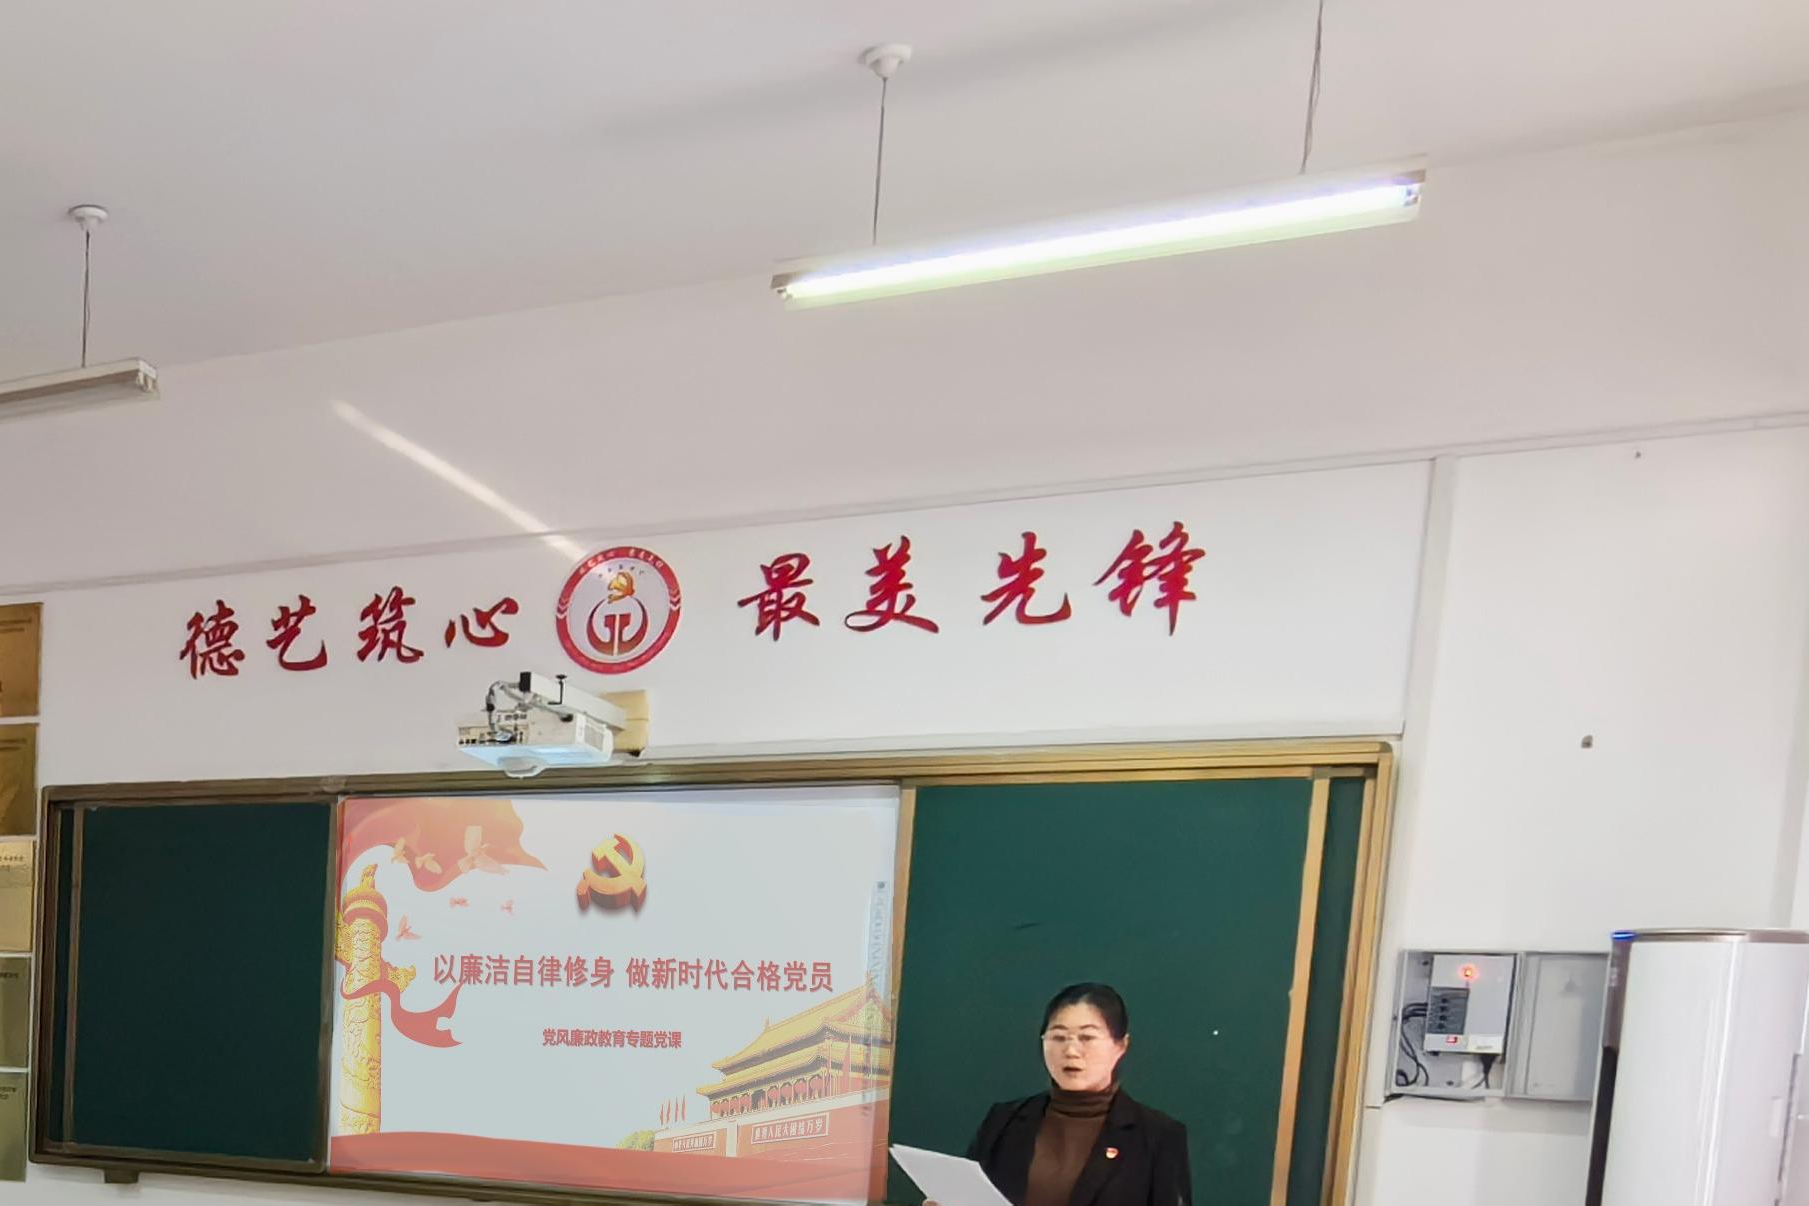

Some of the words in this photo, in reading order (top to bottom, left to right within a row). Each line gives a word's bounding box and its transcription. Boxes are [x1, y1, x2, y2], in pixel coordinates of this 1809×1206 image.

[178, 585, 521, 680] 德艺筑心
[737, 521, 1205, 640] 最美先锋
[433, 953, 615, 988] 以廉洁自律修身
[626, 958, 834, 993] 做新时代合格党员
[542, 1028, 683, 1050] 党风廉政教育专题党课
